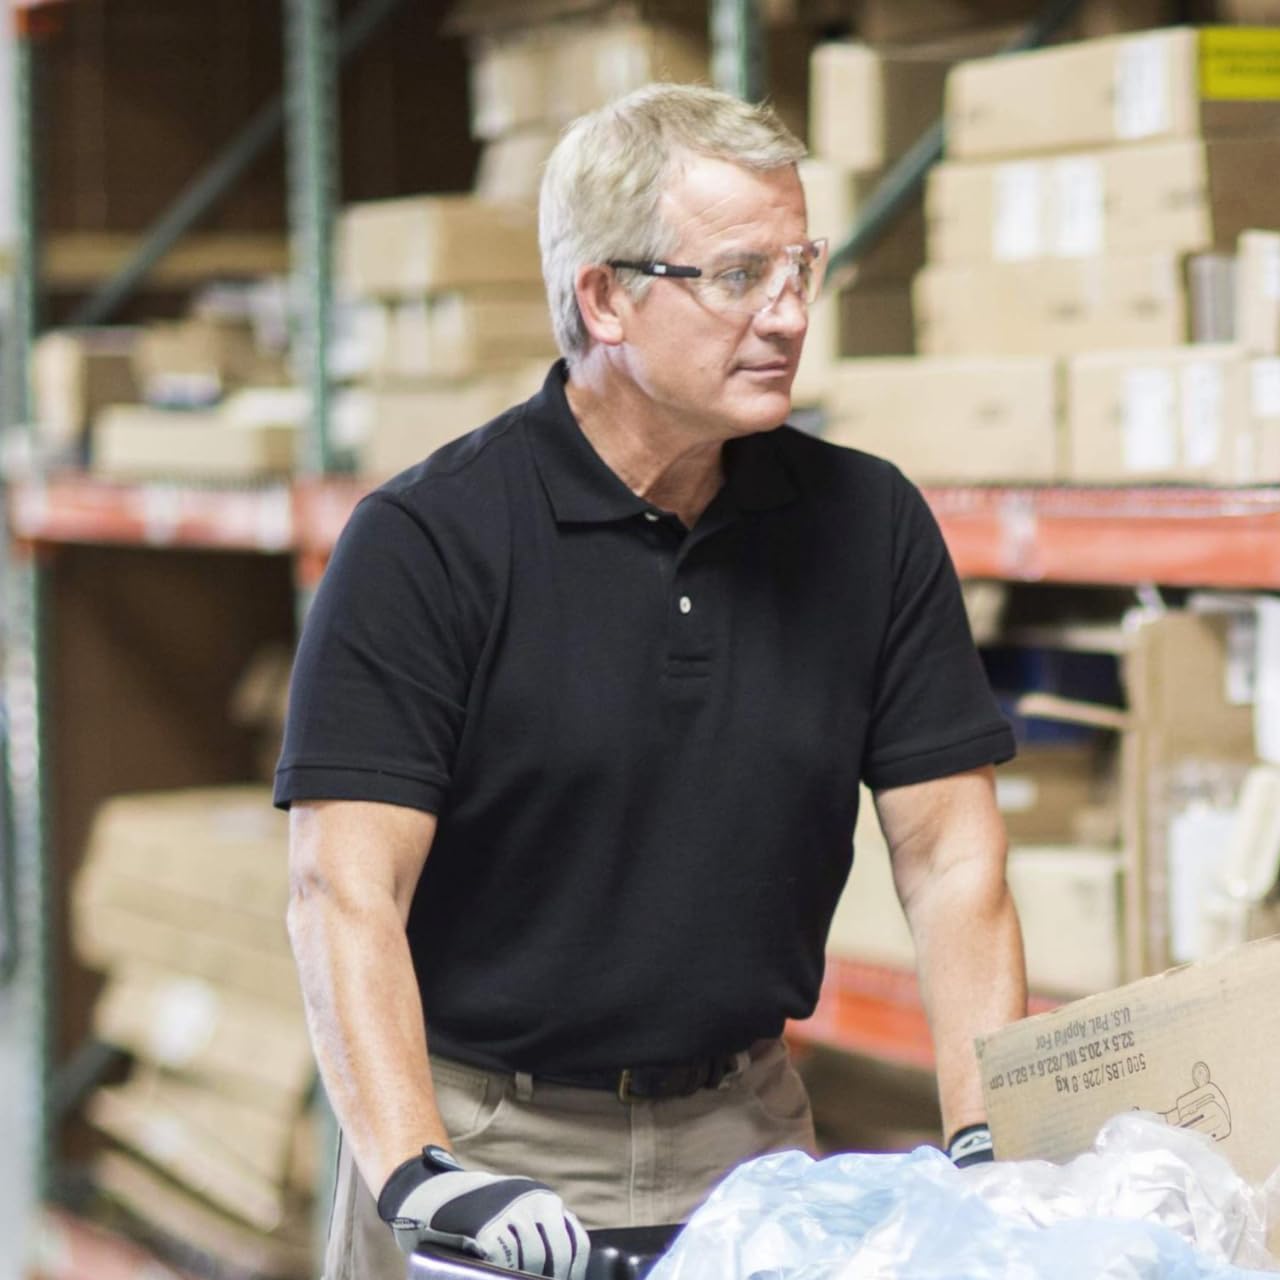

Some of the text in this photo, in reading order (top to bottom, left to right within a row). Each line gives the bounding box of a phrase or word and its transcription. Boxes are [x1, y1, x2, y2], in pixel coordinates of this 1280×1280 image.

[1110, 1007, 1131, 1027] U.S.
[1035, 1033, 1053, 1052] For
[1079, 1041, 1102, 1060] 20.5
[1112, 1030, 1135, 1051] 32.5
[1126, 1053, 1147, 1074] 500
[1007, 1067, 1028, 1087] 52.1
[1055, 1075, 1070, 1094] kg
